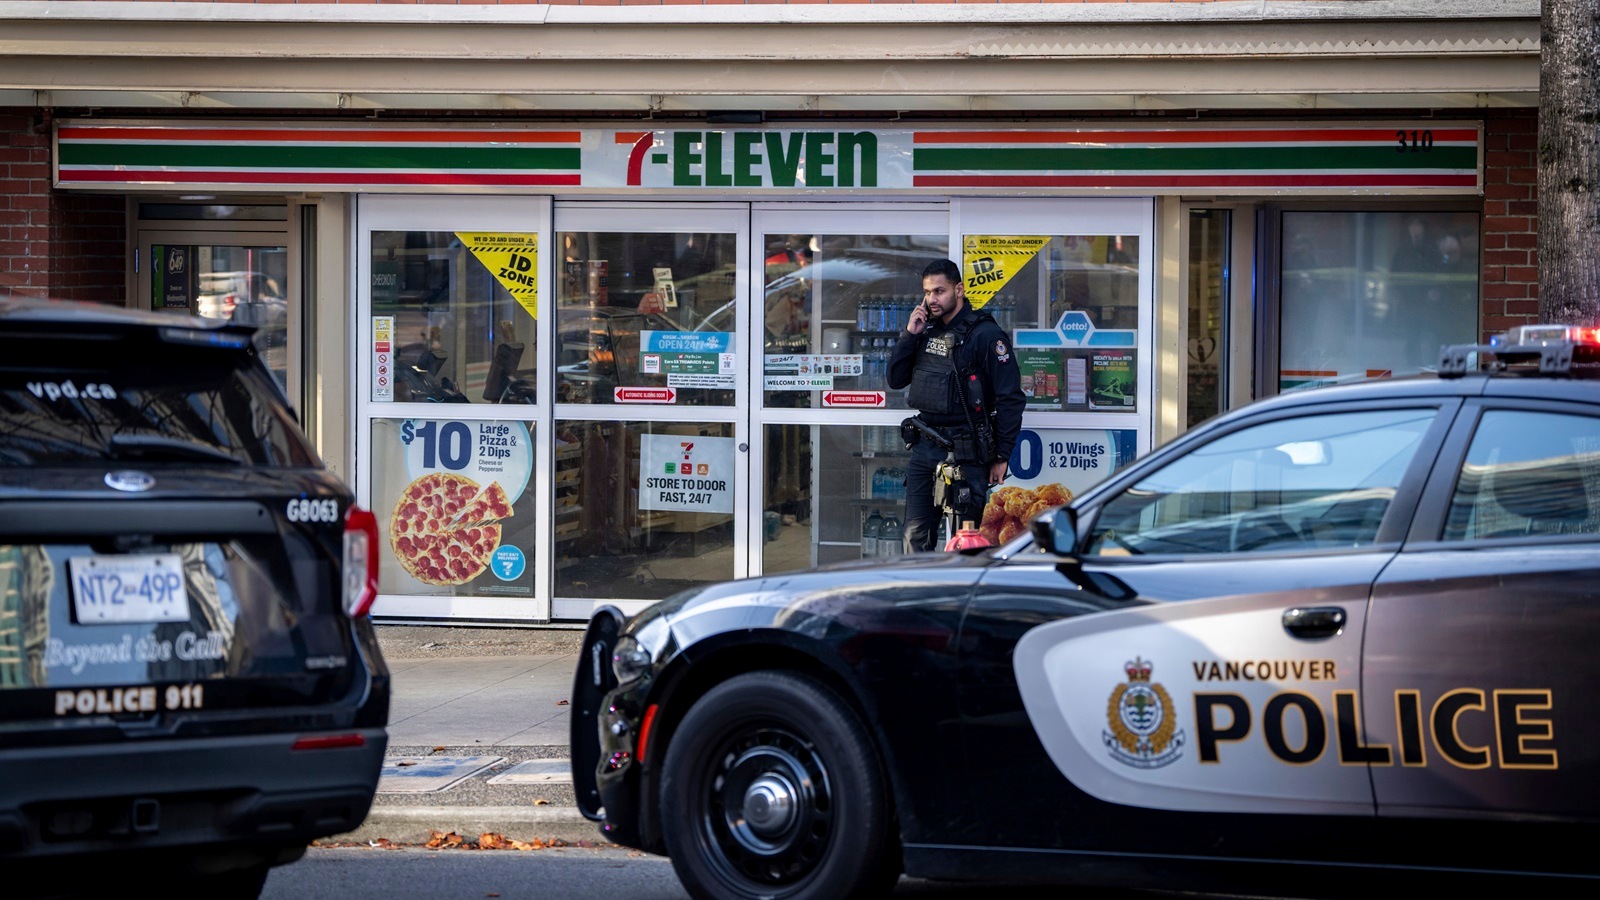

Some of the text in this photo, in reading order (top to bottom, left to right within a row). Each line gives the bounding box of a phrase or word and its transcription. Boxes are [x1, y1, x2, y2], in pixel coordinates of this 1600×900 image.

[1396, 130, 1433, 152] 310
[509, 253, 532, 272] ID
[972, 257, 995, 275] ID
[498, 267, 535, 287] ZONE
[967, 270, 1004, 288] ZONE
[1062, 322, 1088, 331] lotto!
[658, 340, 704, 350] OPEN 24/7
[926, 341, 948, 352] POLICE
[26, 379, 117, 401] vpd.ca
[480, 423, 510, 436] Large
[401, 420, 472, 470] $10
[480, 435, 517, 447] Pizza &
[1048, 442, 1105, 458] 10 Wings
[479, 446, 511, 460] 2 Dips
[1048, 456, 1098, 470] & 2 Dips
[646, 477, 726, 491] STORE TO DOOR
[660, 492, 712, 505] FAST, 24/7
[44, 630, 224, 675] Beyond the Call
[1192, 660, 1338, 682] VANCOUVER
[54, 684, 204, 715] POLICE 911
[1192, 687, 1559, 770] POLICE
